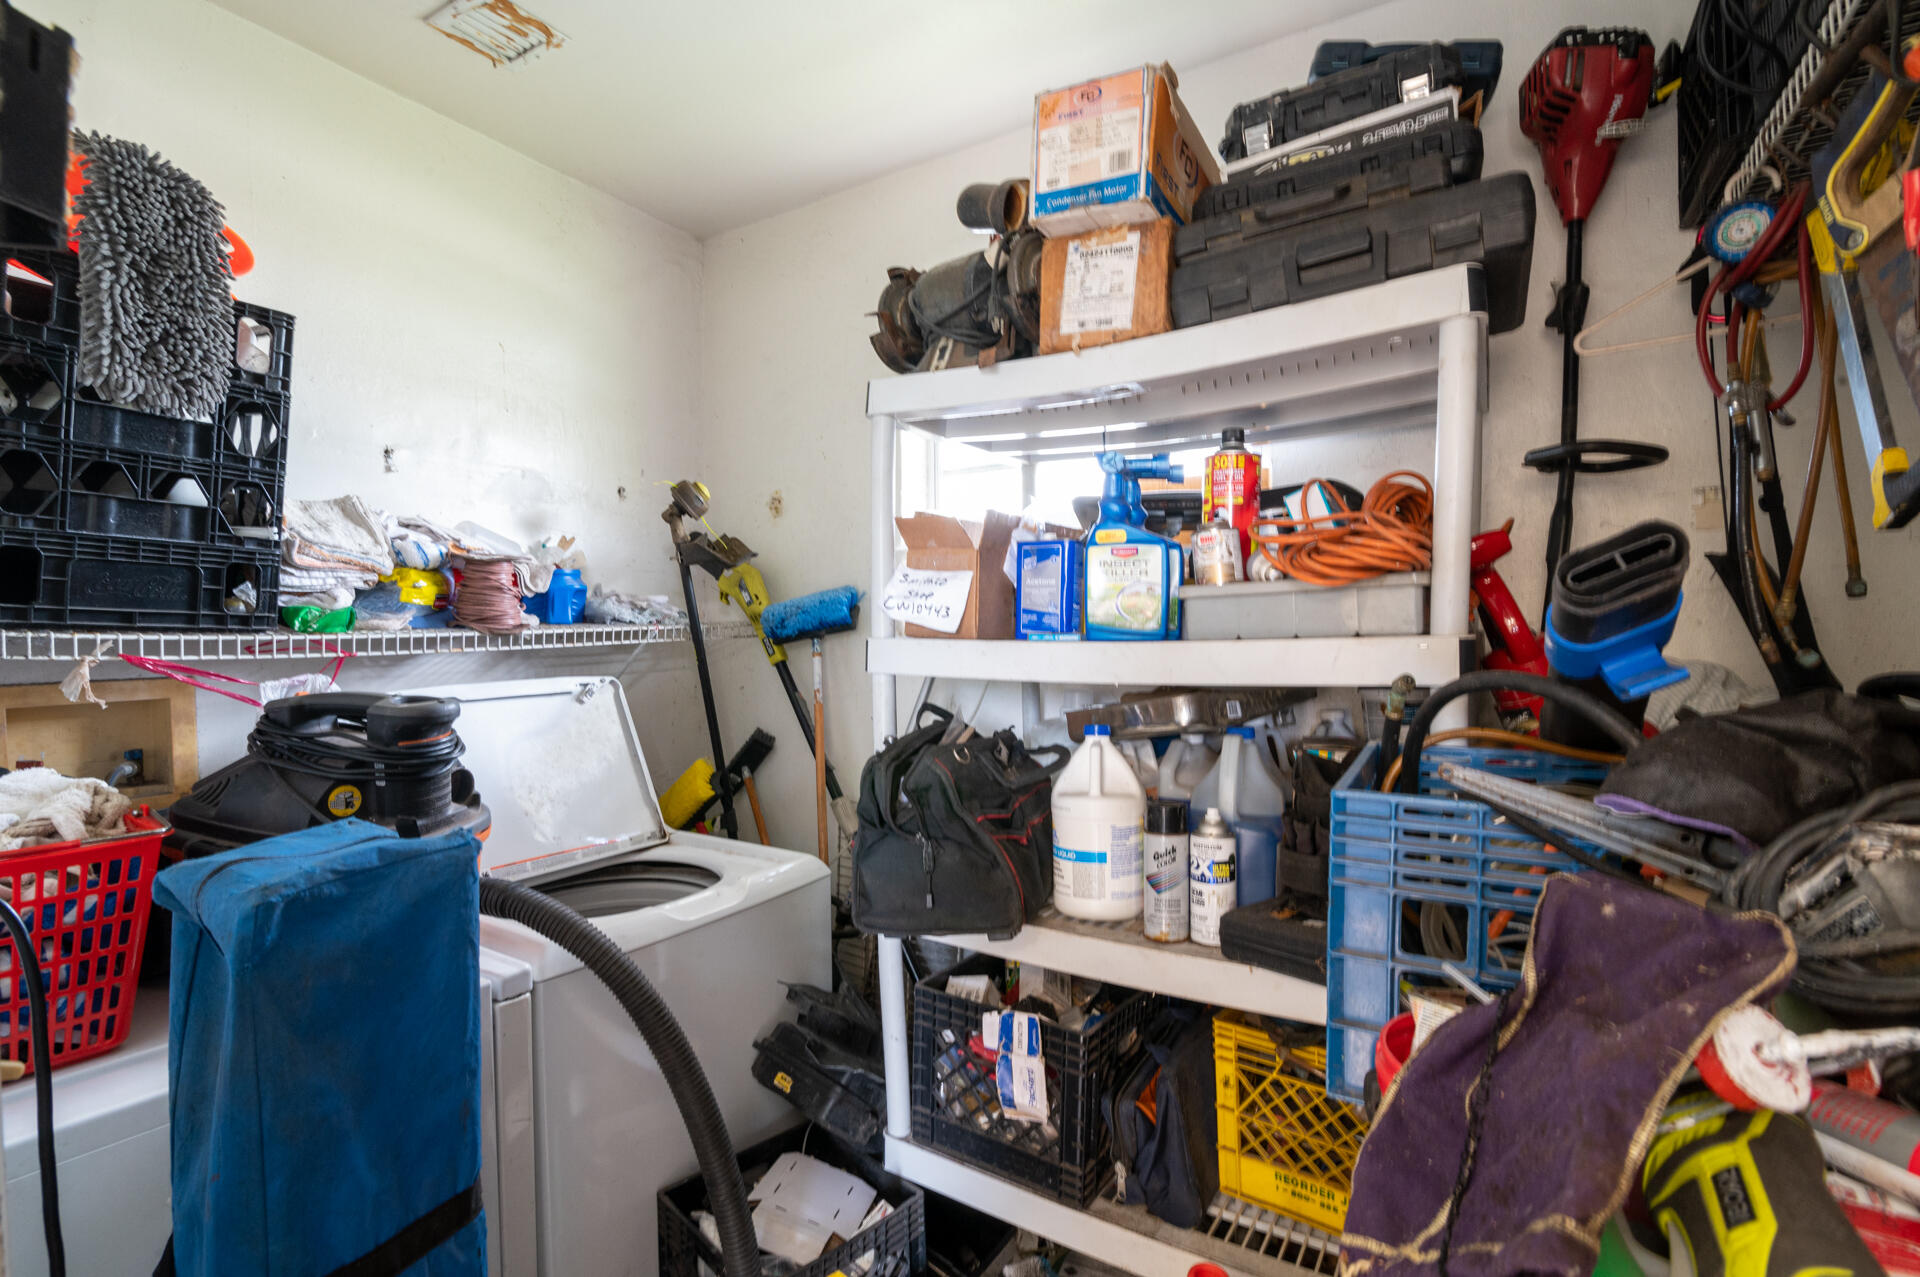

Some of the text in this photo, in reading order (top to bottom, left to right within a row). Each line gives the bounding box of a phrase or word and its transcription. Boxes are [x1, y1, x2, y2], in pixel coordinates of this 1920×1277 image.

[1046, 193, 1087, 208] Condenser
[1103, 183, 1127, 197] Motor
[1099, 559, 1150, 568] INSECT
[1153, 844, 1177, 861] Quick
[1275, 1171, 1335, 1202] REORDER
